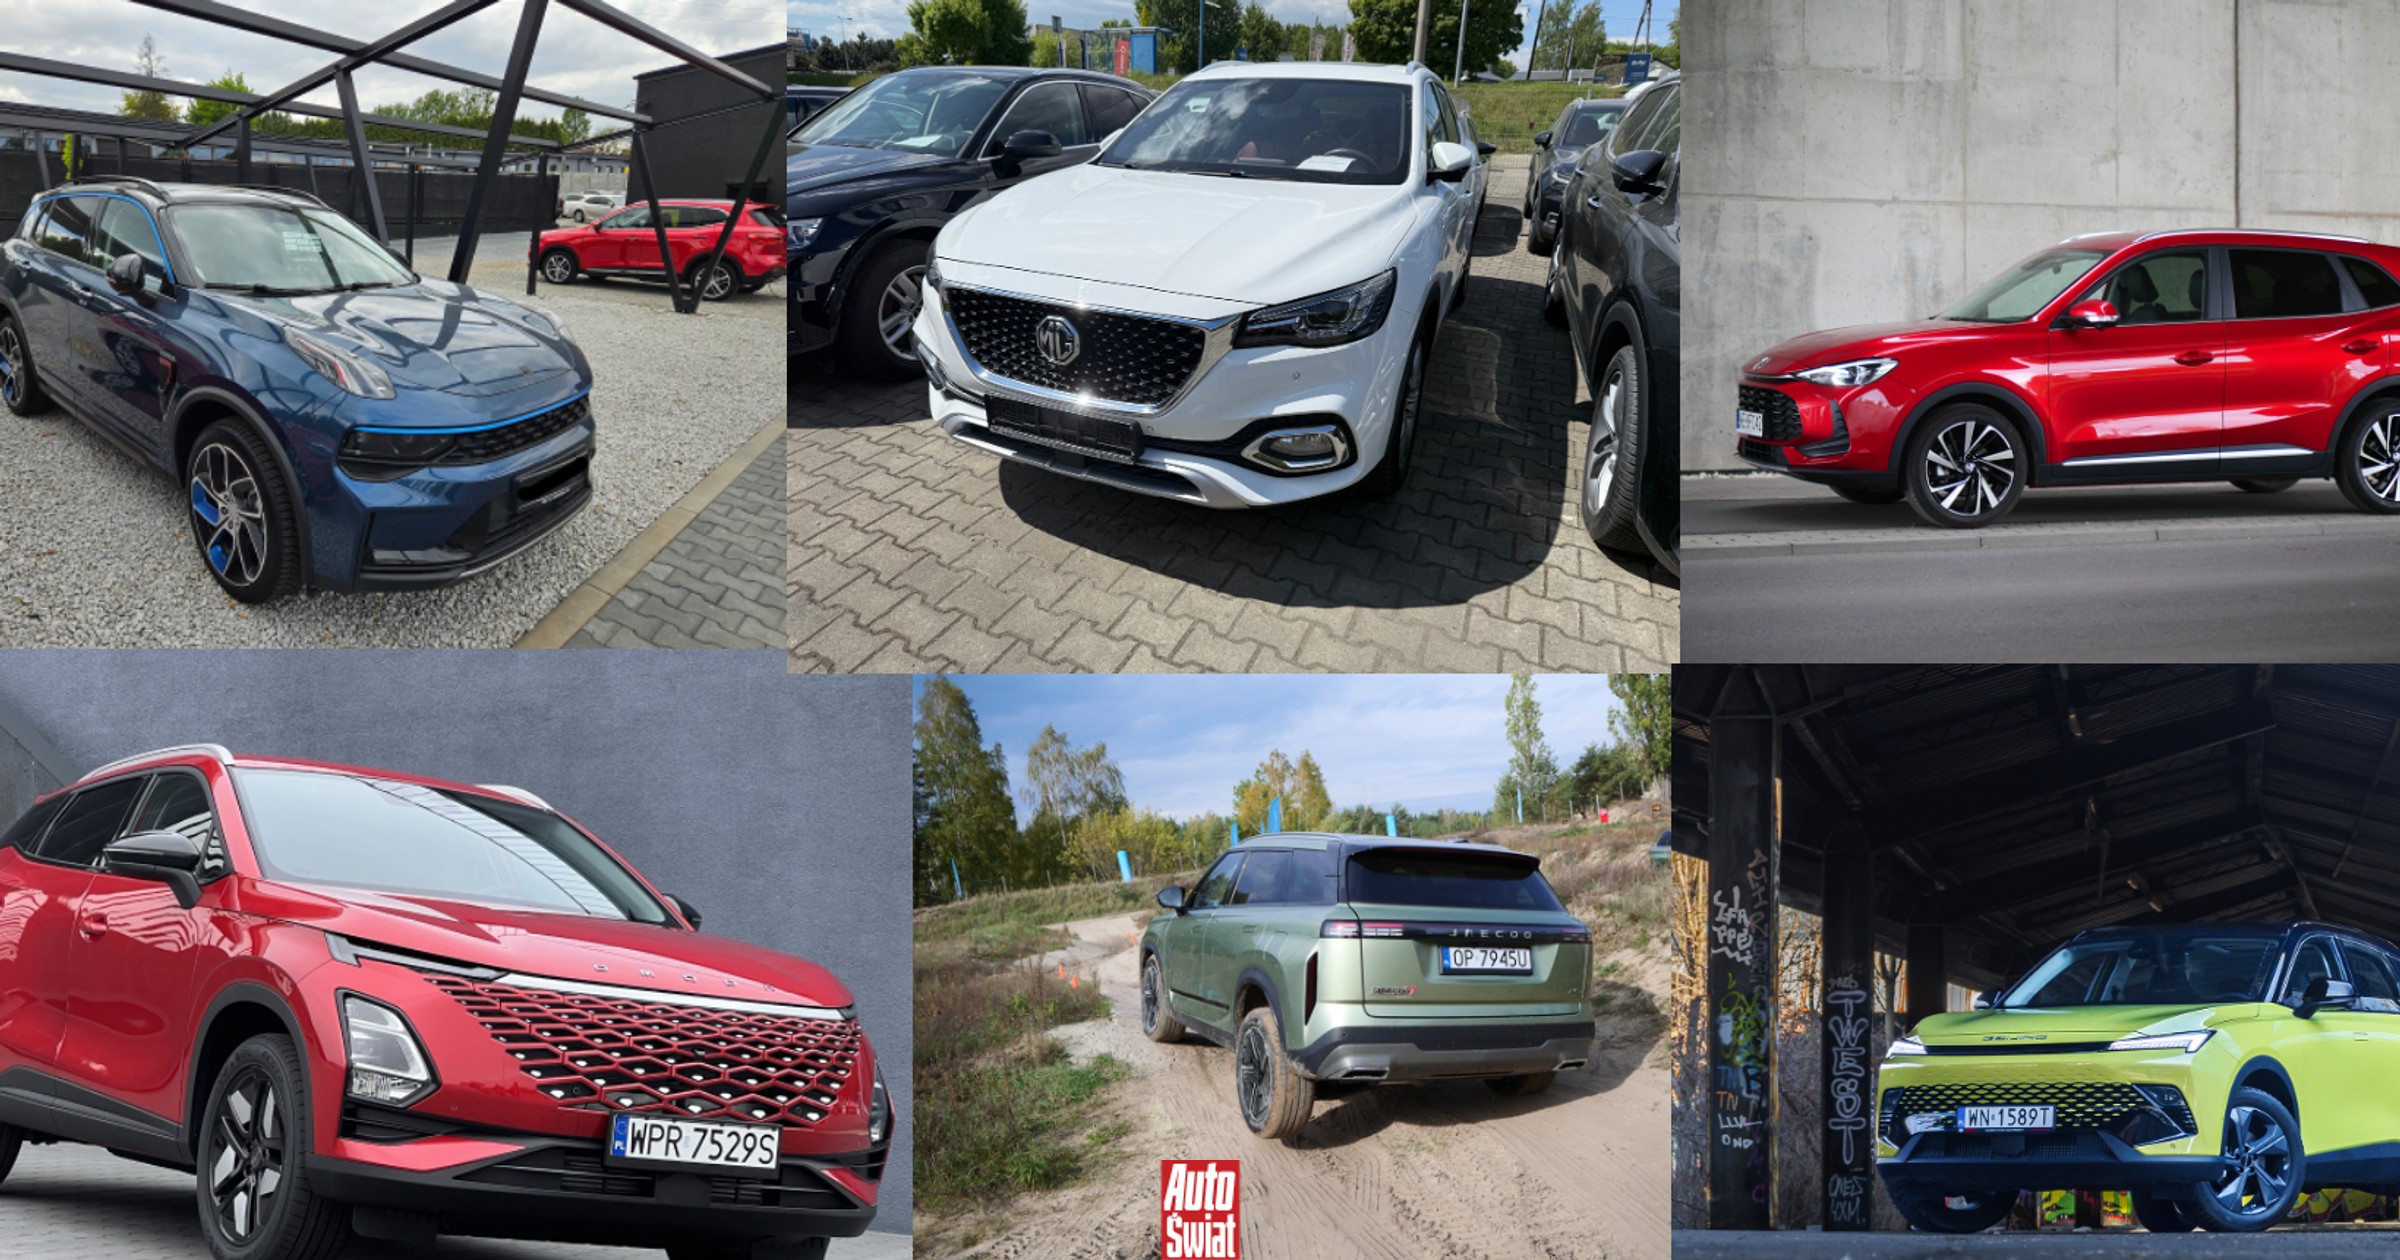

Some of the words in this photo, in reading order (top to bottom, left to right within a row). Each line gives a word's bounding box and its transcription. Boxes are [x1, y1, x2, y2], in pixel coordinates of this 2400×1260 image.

[1038, 319, 1074, 361] MG
[1453, 949, 1474, 967] OP
[1480, 949, 1528, 968] 7945U
[1968, 1107, 1990, 1127] WN
[1997, 1107, 2050, 1127] 1589T
[630, 1122, 683, 1158] WPR
[691, 1127, 775, 1165] 7529S
